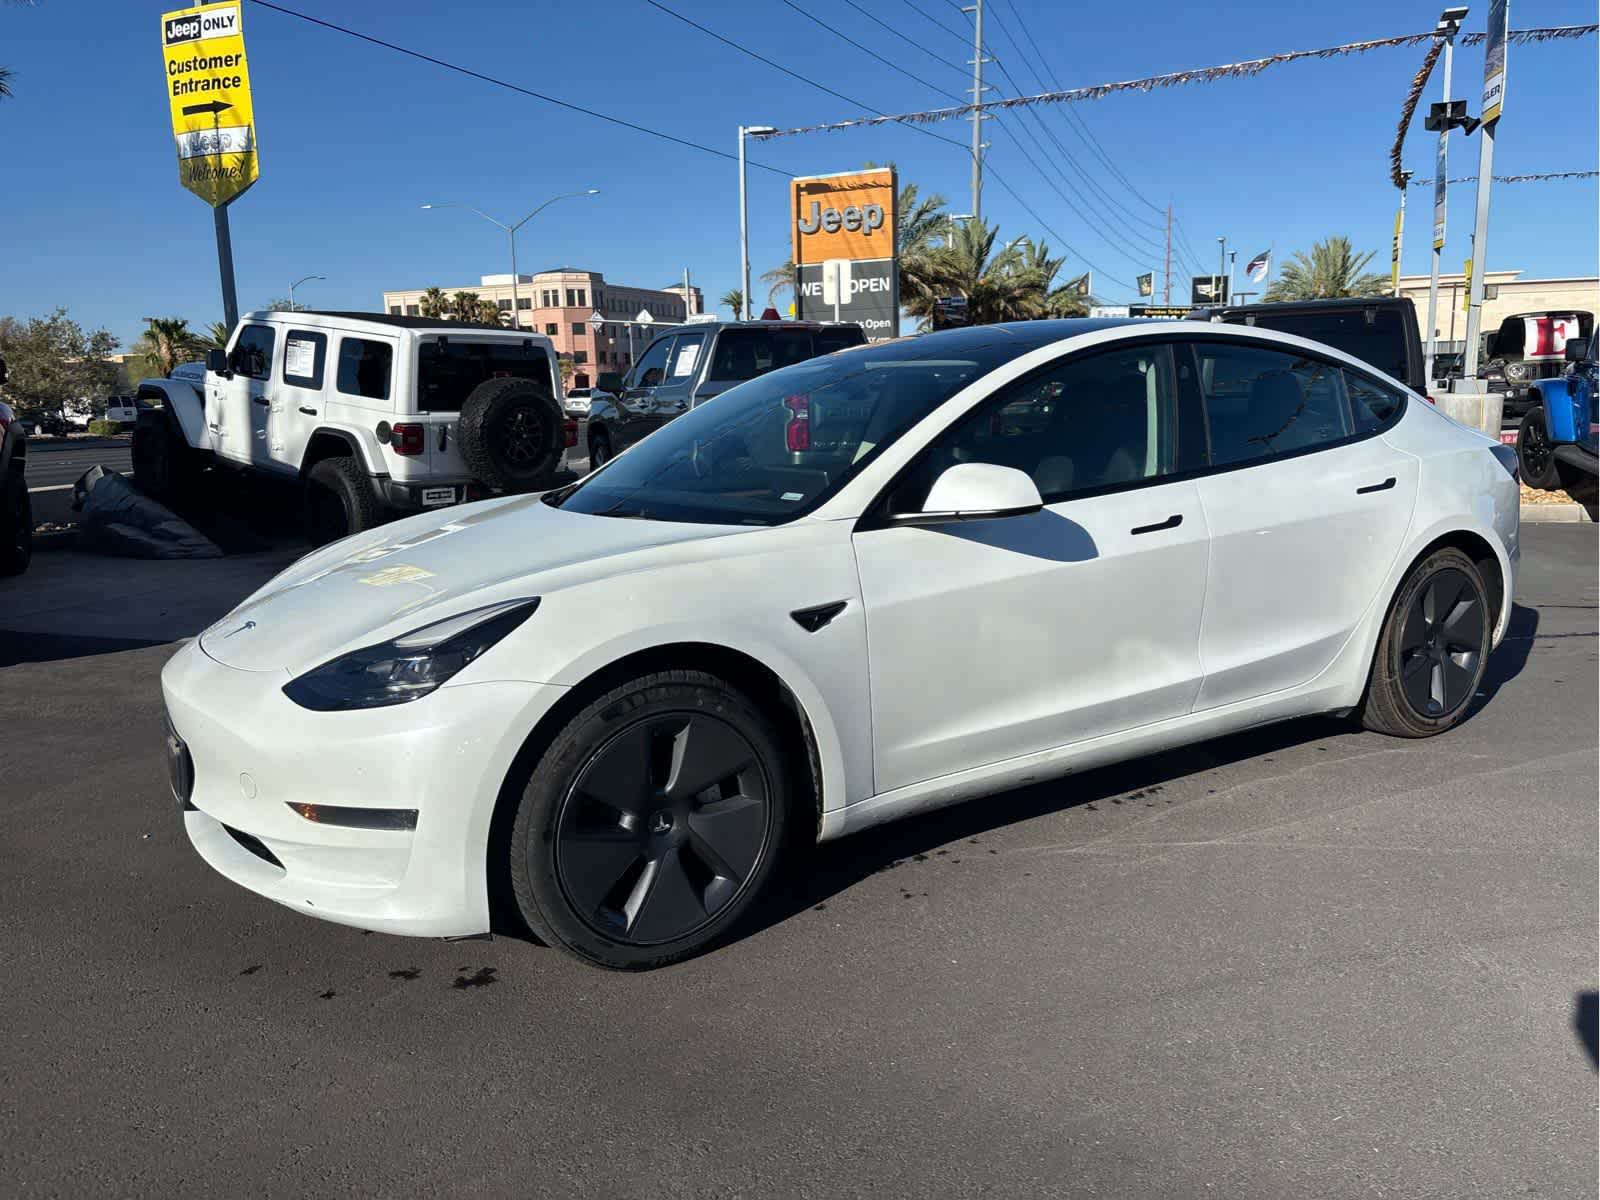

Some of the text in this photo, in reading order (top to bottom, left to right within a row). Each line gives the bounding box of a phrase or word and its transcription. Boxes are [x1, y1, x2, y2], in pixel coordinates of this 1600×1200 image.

[167, 15, 235, 39] Jeep ONLY
[168, 53, 242, 76] Customer
[173, 75, 241, 97] Entrance
[191, 132, 232, 152] Jeep
[190, 159, 245, 182] Welcome!
[798, 200, 883, 236] Jeep
[849, 276, 890, 295] OPEN
[865, 318, 891, 330] Open
